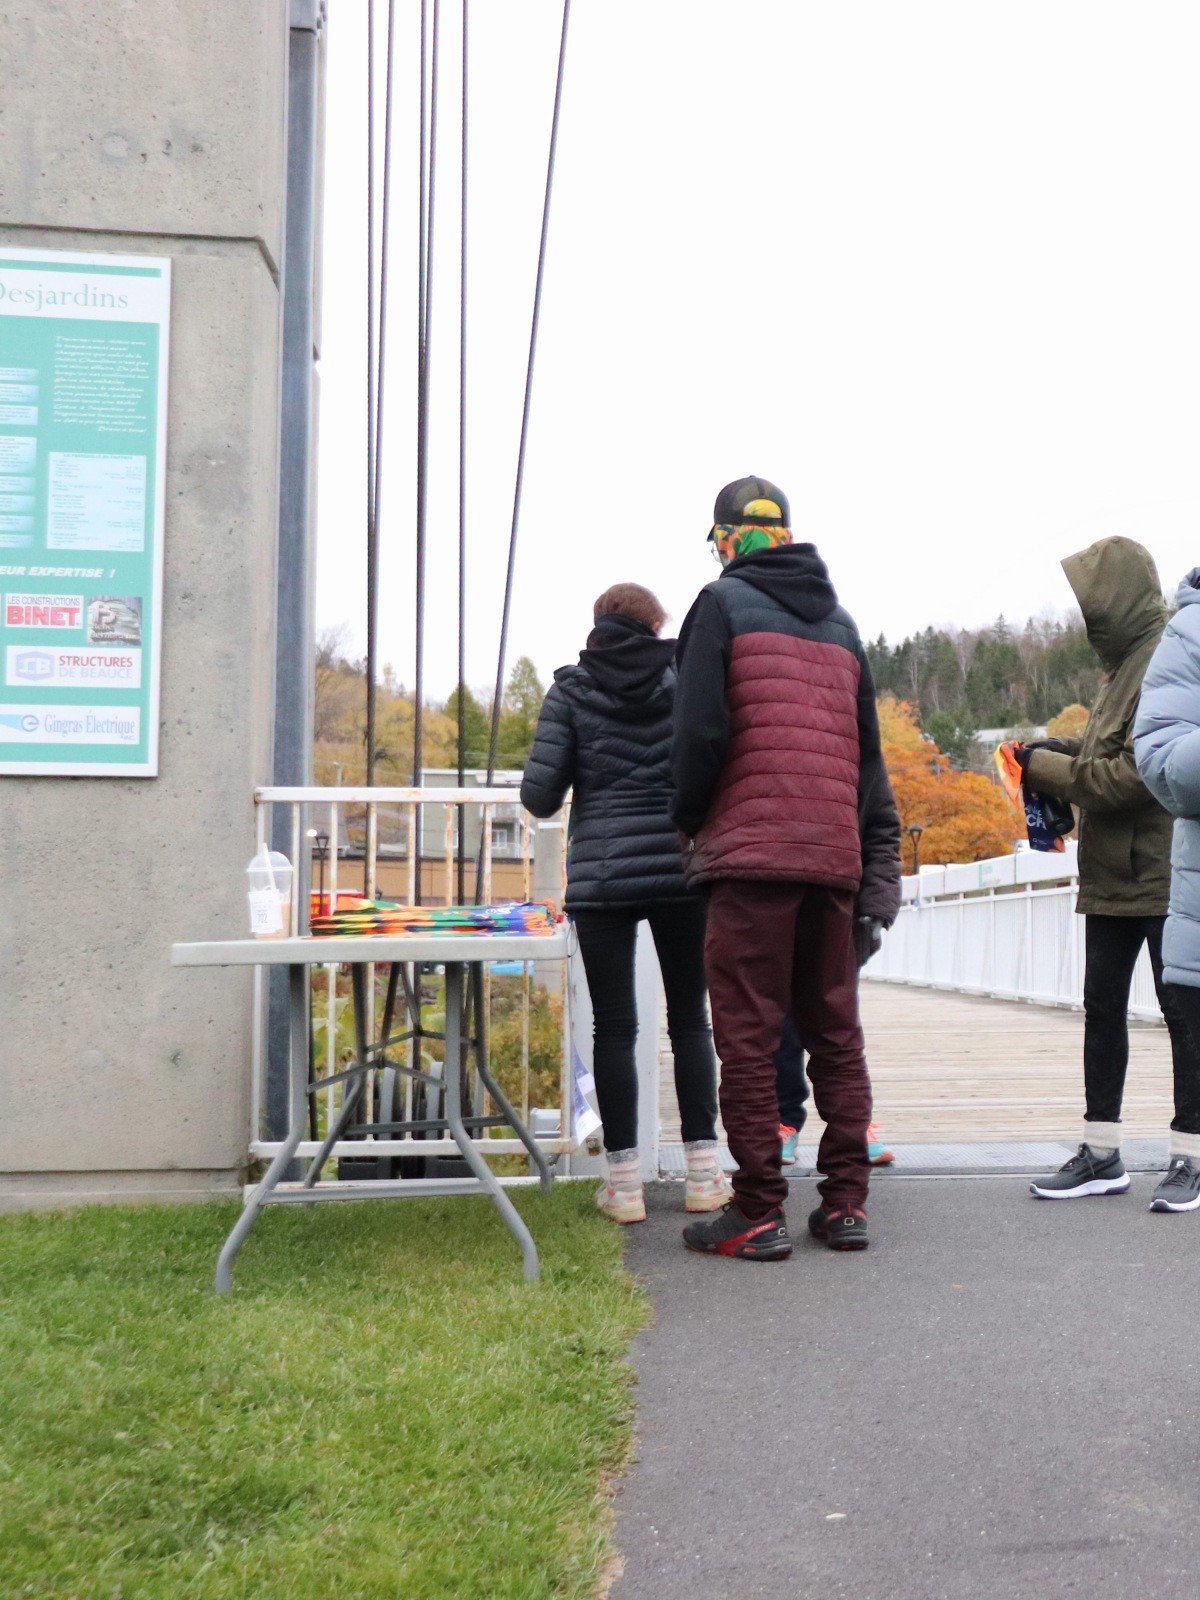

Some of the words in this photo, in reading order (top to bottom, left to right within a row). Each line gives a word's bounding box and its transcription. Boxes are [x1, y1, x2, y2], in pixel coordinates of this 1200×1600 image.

[0, 282, 129, 311] esjardins
[28, 567, 104, 578] EXPERTISE
[8, 596, 20, 605] LES
[22, 597, 80, 606] CONSTRUCTIONS
[7, 605, 80, 626] BINET
[59, 655, 133, 668] STRUCTURES
[59, 668, 77, 678] DE
[81, 668, 133, 679] BEAUCE
[44, 714, 83, 737] Gingras
[86, 709, 135, 736] Électrique
